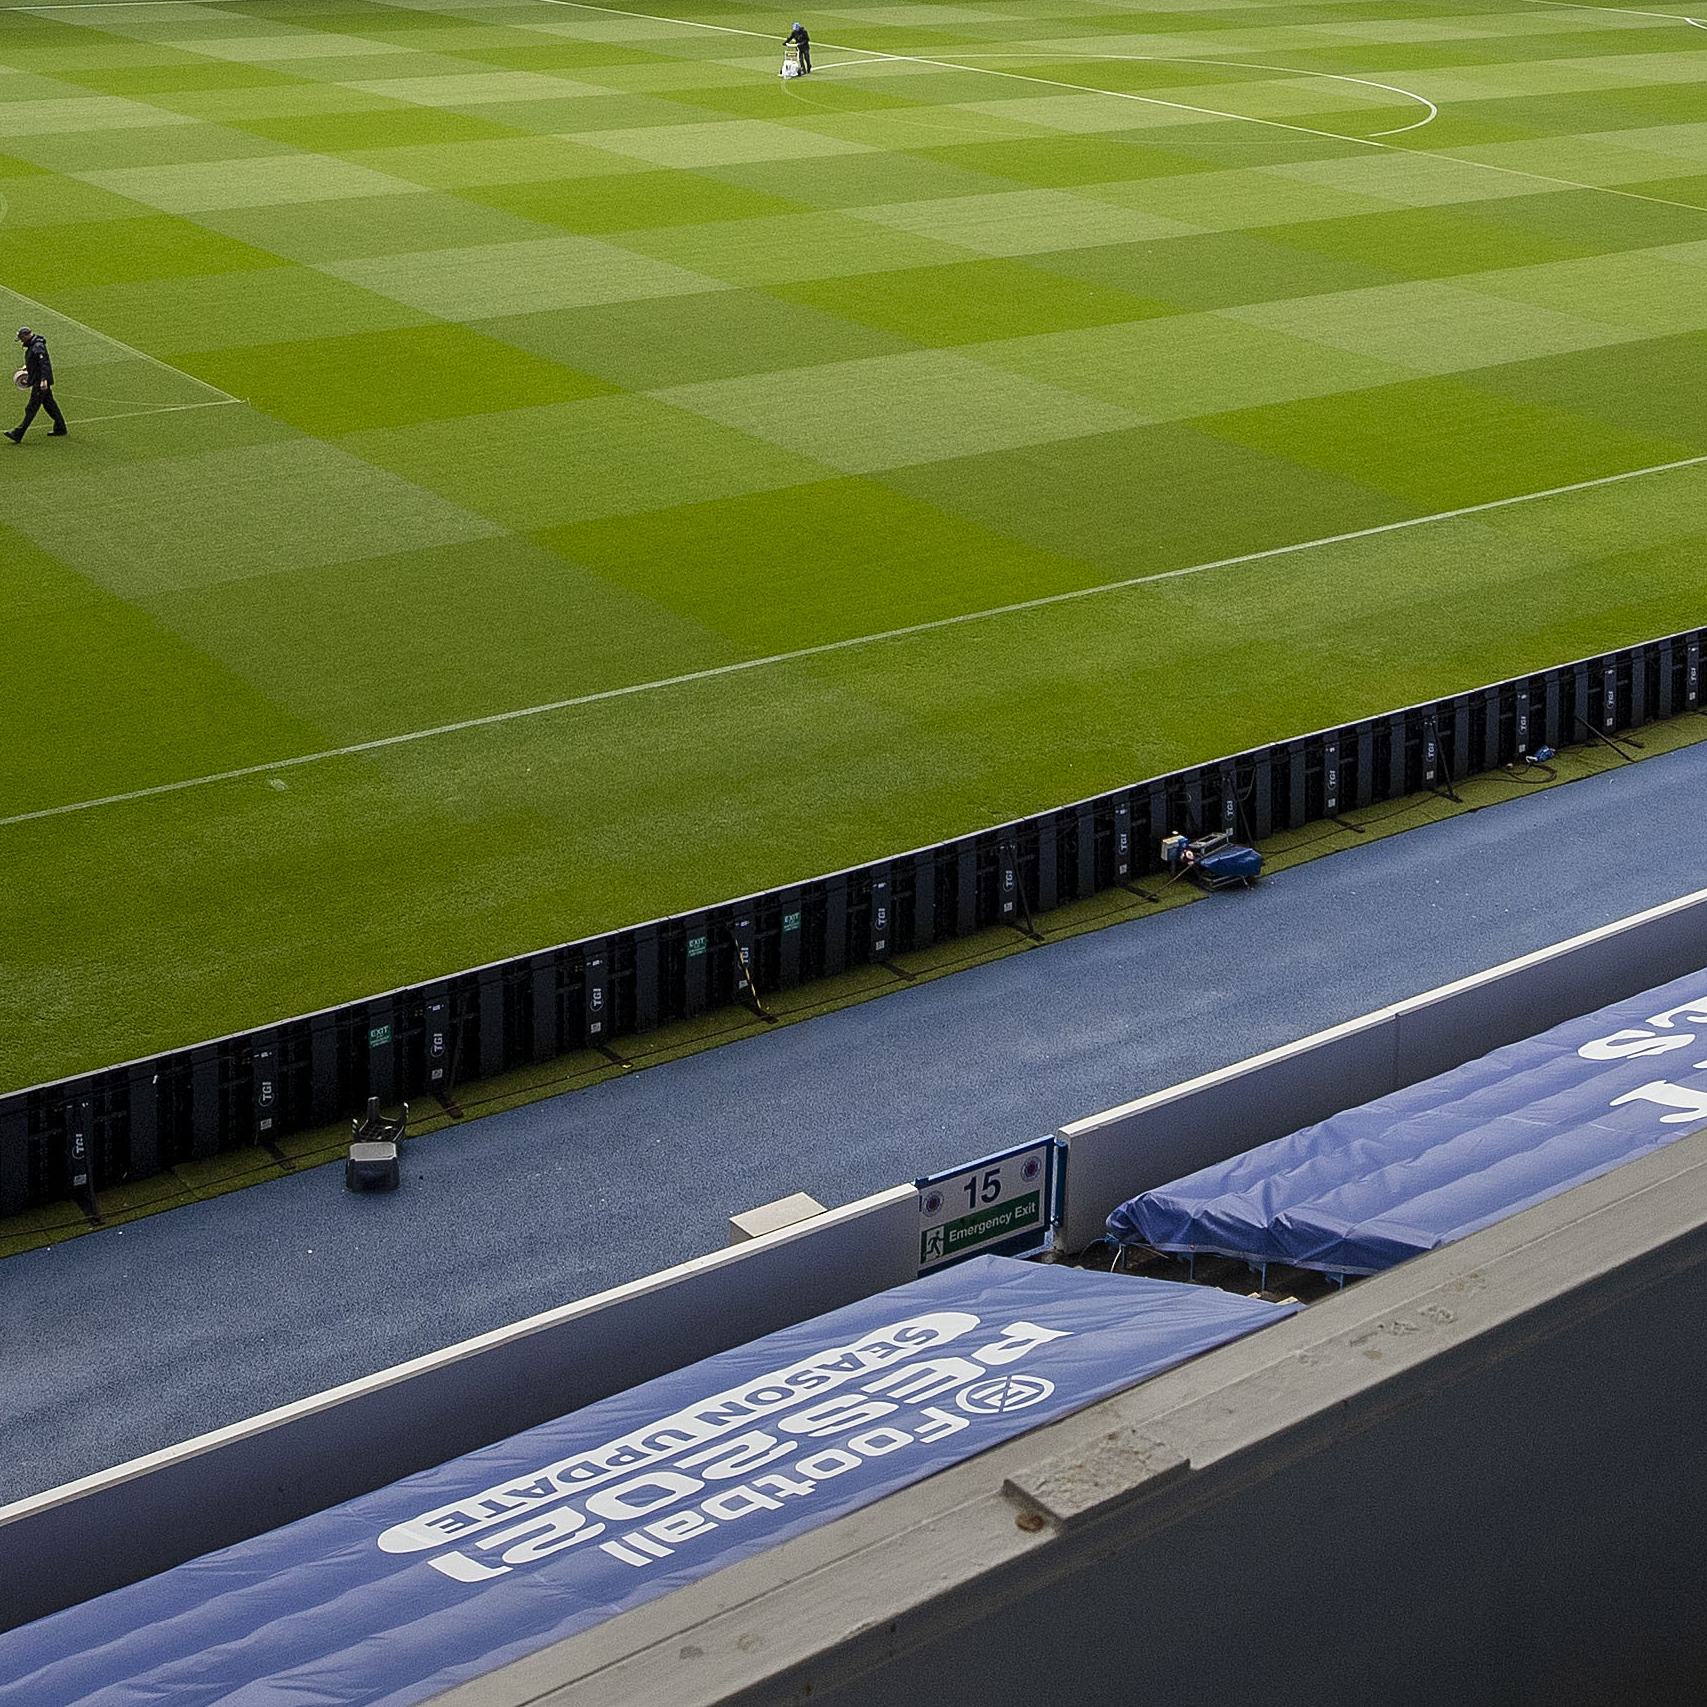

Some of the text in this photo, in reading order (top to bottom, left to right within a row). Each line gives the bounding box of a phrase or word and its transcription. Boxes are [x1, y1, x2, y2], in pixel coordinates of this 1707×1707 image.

[592, 987, 602, 1009] TGI
[370, 1026, 389, 1038] EXIT
[433, 1033, 443, 1055] TGI
[262, 1081, 272, 1103] TGI
[963, 1168, 1002, 1209] 15
[949, 1201, 1036, 1243] Emergency Exit
[423, 1324, 942, 1539] SEASON UPDATE
